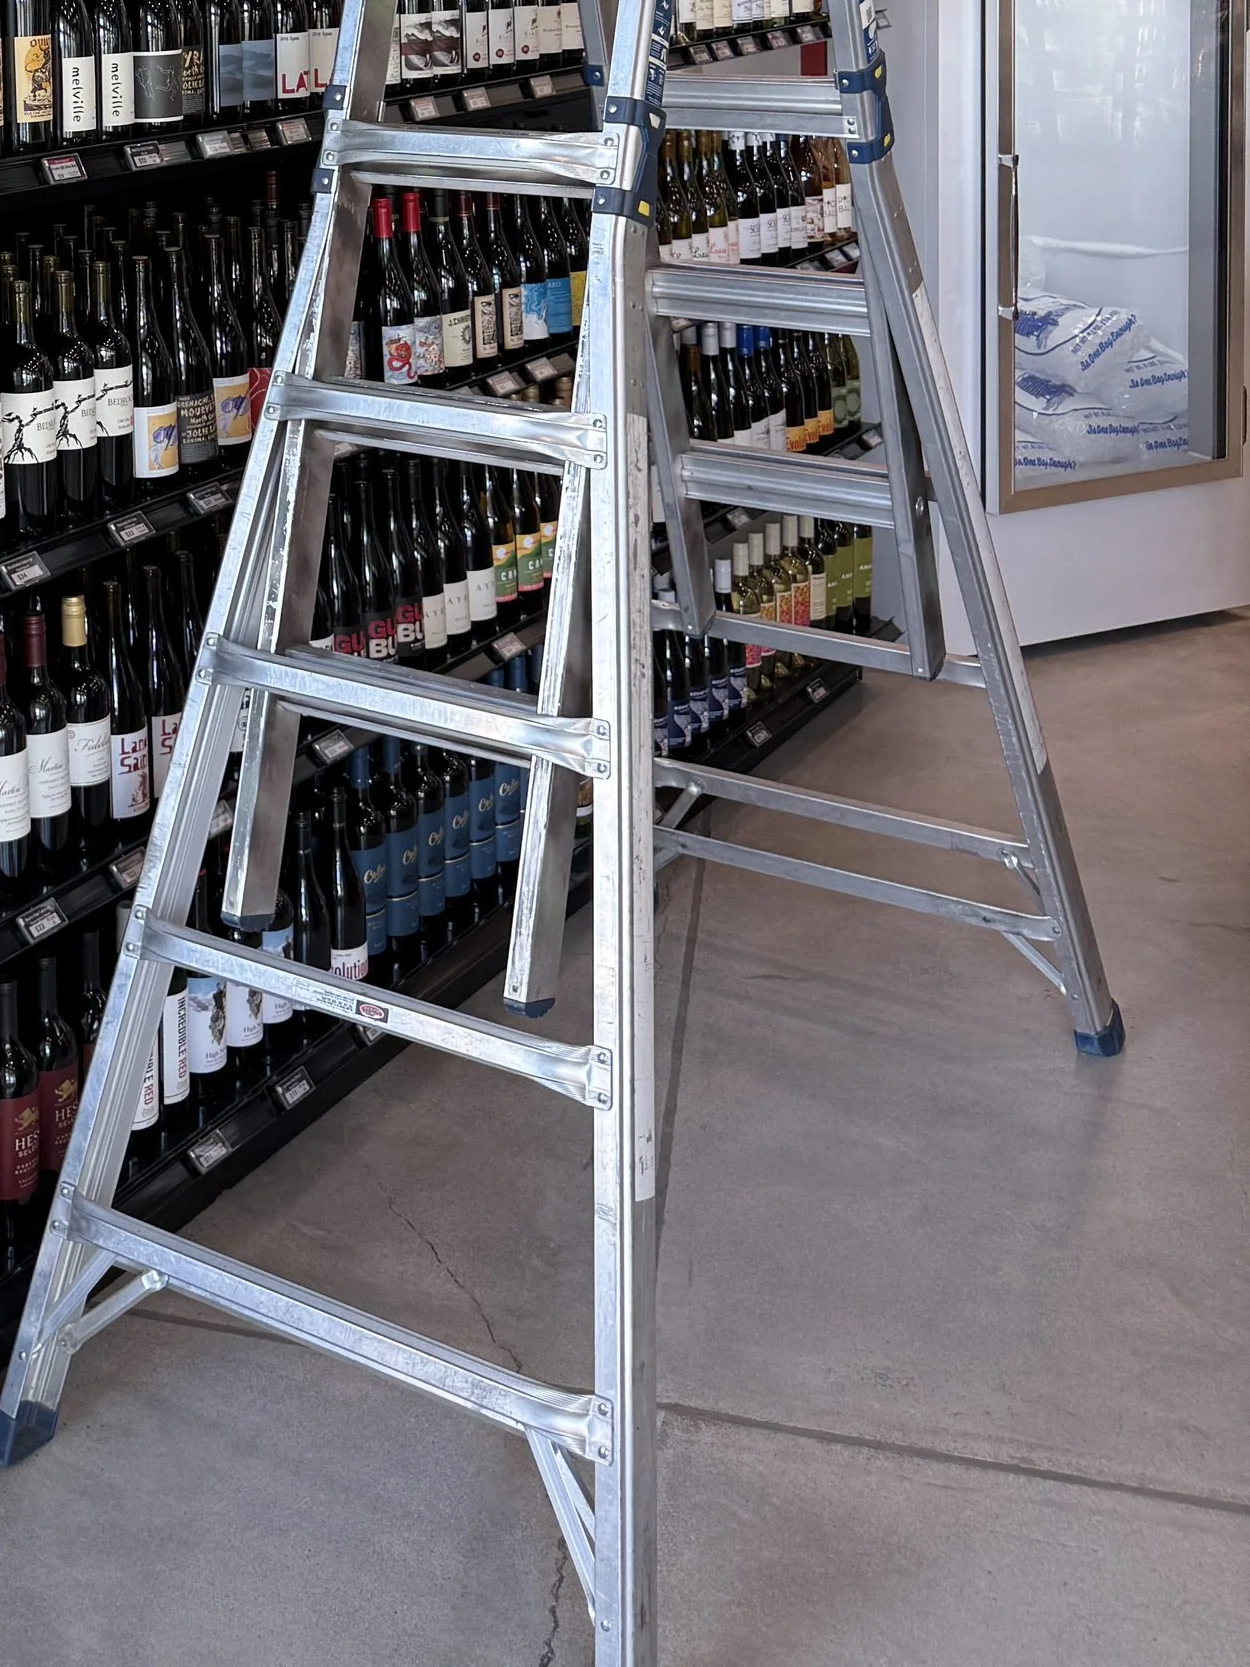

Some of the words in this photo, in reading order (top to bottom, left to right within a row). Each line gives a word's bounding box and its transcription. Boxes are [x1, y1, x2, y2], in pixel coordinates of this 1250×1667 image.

[71, 66, 84, 123] melville
[111, 62, 124, 118] melville
[1099, 337, 1114, 352] Bag
[176, 996, 187, 1056] INCREDIBLE
[177, 1057, 187, 1080] RED
[143, 1084, 152, 1105] RED
